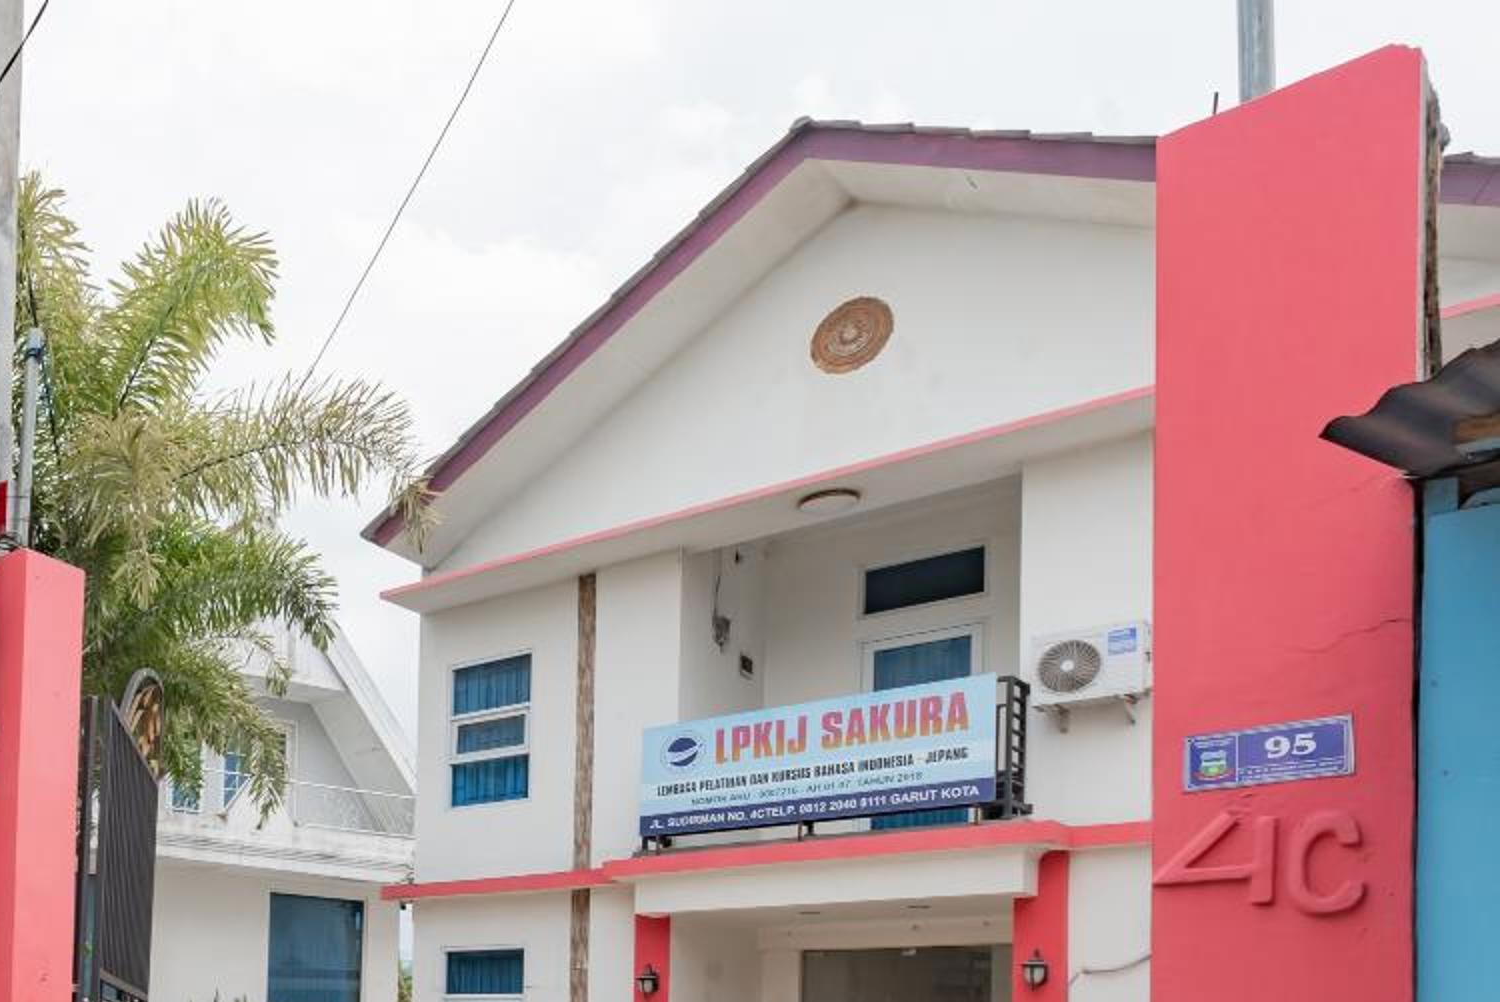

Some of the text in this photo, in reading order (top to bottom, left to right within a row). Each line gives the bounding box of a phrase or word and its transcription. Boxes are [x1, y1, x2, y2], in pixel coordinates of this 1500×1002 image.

[714, 691, 970, 765] LPKIJ SAKURA
[1265, 732, 1317, 759] 95
[657, 782, 697, 797] LEMBAGA
[700, 776, 747, 791] PELATIHAN
[750, 772, 769, 785] DAN
[771, 767, 811, 783] KURSUS
[814, 761, 855, 778] BAHASA
[858, 754, 915, 772] INDONESIA
[926, 747, 969, 764] JEPANG
[667, 812, 726, 827] SUDIRMAN
[890, 789, 938, 804] GARUT
[941, 785, 980, 799] KOTA
[1152, 807, 1368, 917] 4C
